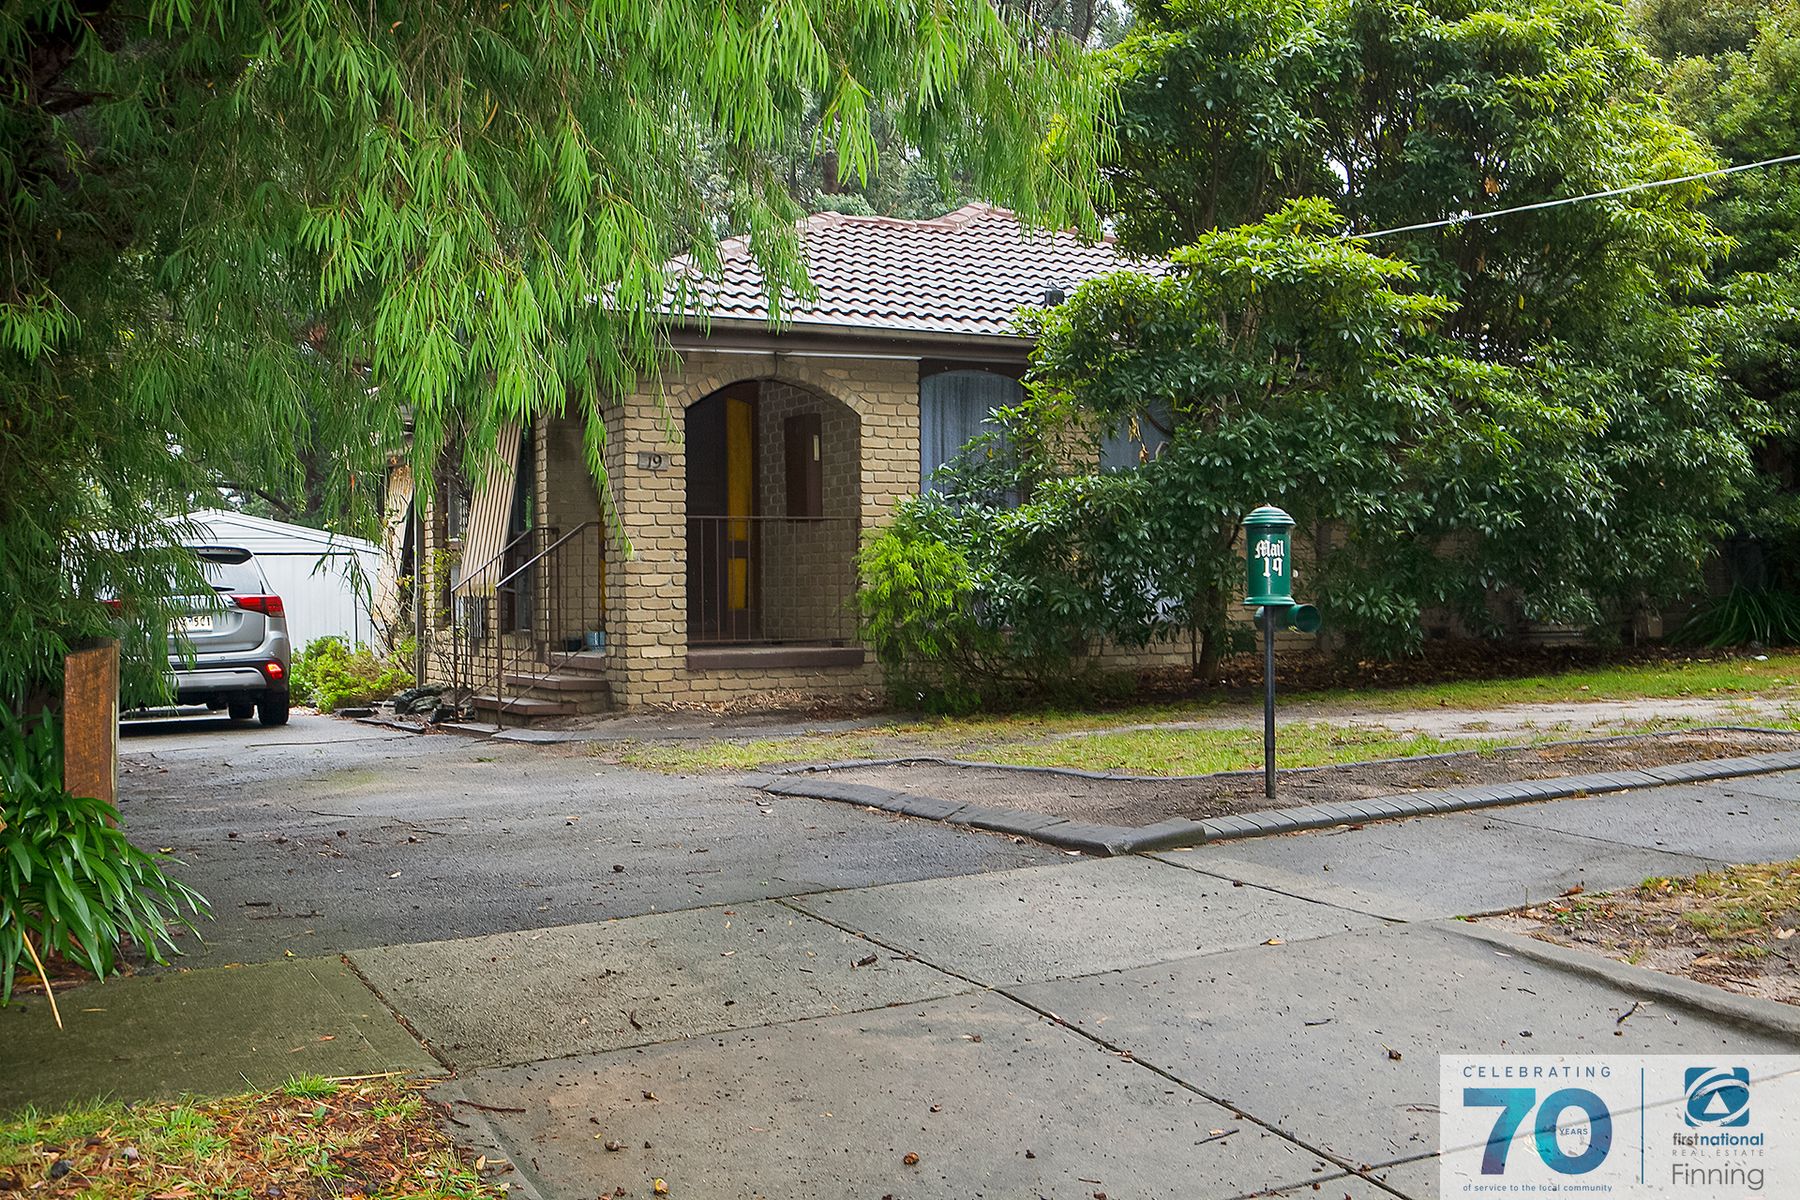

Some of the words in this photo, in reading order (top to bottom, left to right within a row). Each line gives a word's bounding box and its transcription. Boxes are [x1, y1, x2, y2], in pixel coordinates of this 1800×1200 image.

[648, 454, 662, 469] 19
[1254, 540, 1285, 559] Mail
[1263, 557, 1283, 577] 19
